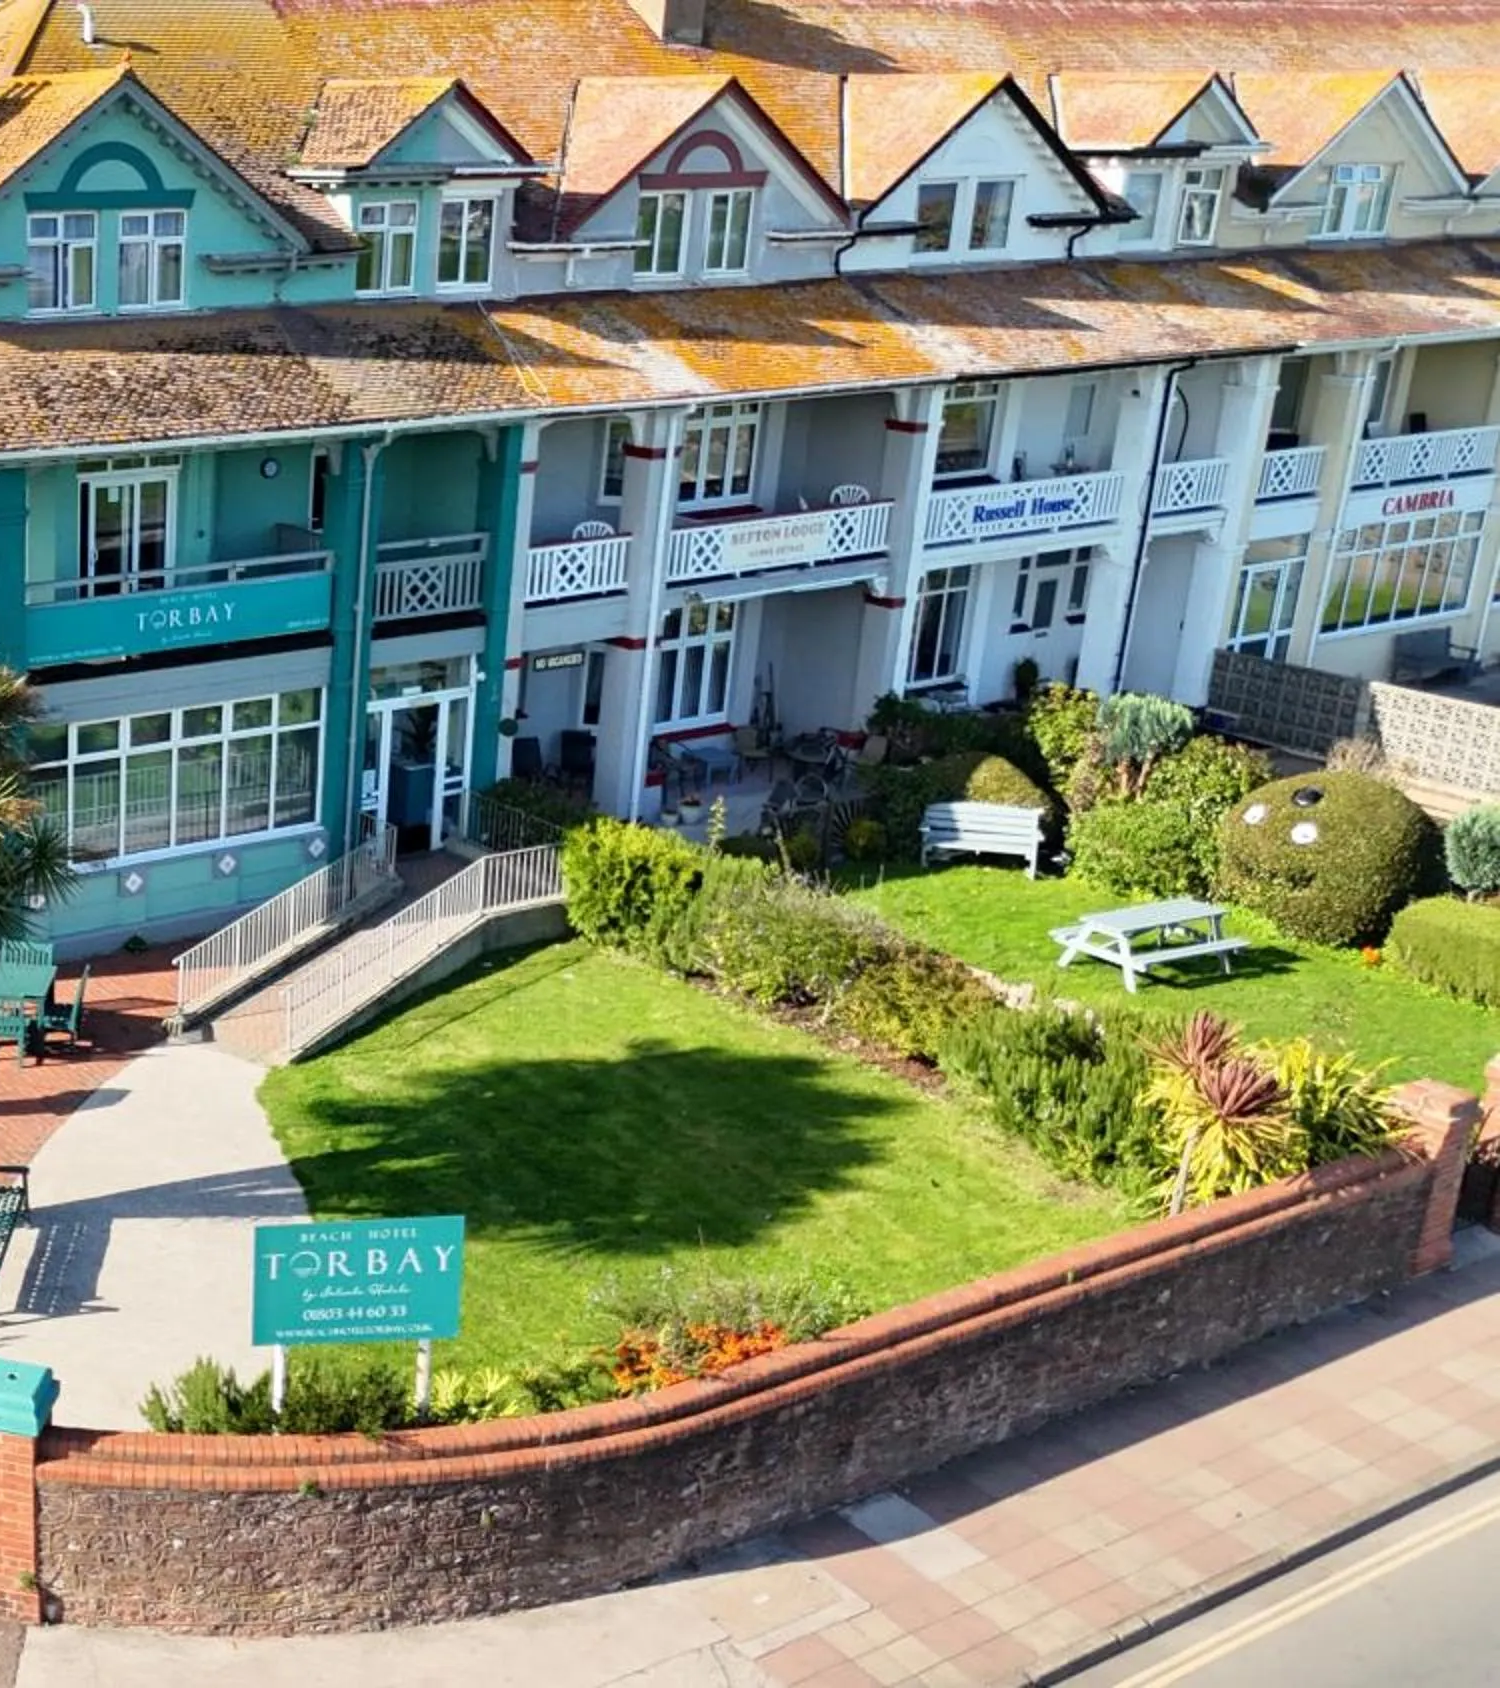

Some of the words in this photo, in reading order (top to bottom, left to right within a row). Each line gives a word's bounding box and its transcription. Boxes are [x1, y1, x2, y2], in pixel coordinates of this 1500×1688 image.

[972, 499, 1027, 523] Russell
[1031, 497, 1075, 516] House
[1382, 489, 1454, 516] CAMBRIA
[731, 527, 781, 545] SEFTON
[783, 522, 825, 539] LODGE
[134, 602, 237, 632] TORBAY
[535, 658, 546, 669] NO
[300, 1231, 352, 1243] BEACH
[367, 1227, 417, 1239] HOTEL
[262, 1245, 455, 1280] TORBAY
[366, 1305, 386, 1318] 60
